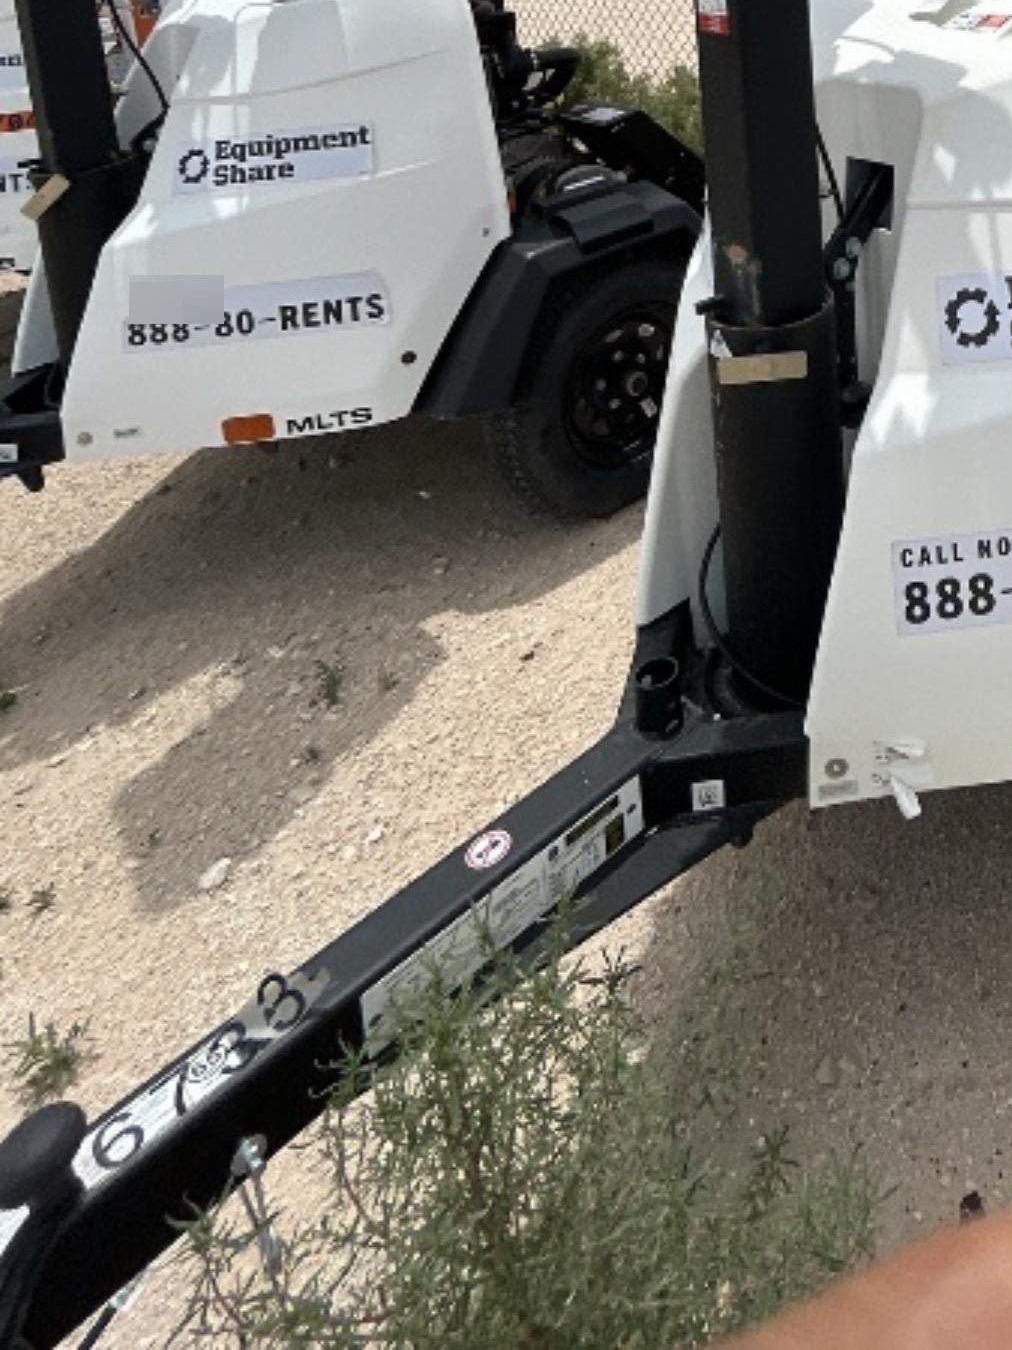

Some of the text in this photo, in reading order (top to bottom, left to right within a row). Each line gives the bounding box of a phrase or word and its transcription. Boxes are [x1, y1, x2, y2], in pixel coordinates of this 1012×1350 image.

[213, 126, 371, 163] Equipment
[213, 156, 295, 186] Share
[286, 407, 374, 435] MLTS
[899, 541, 965, 570] CALL
